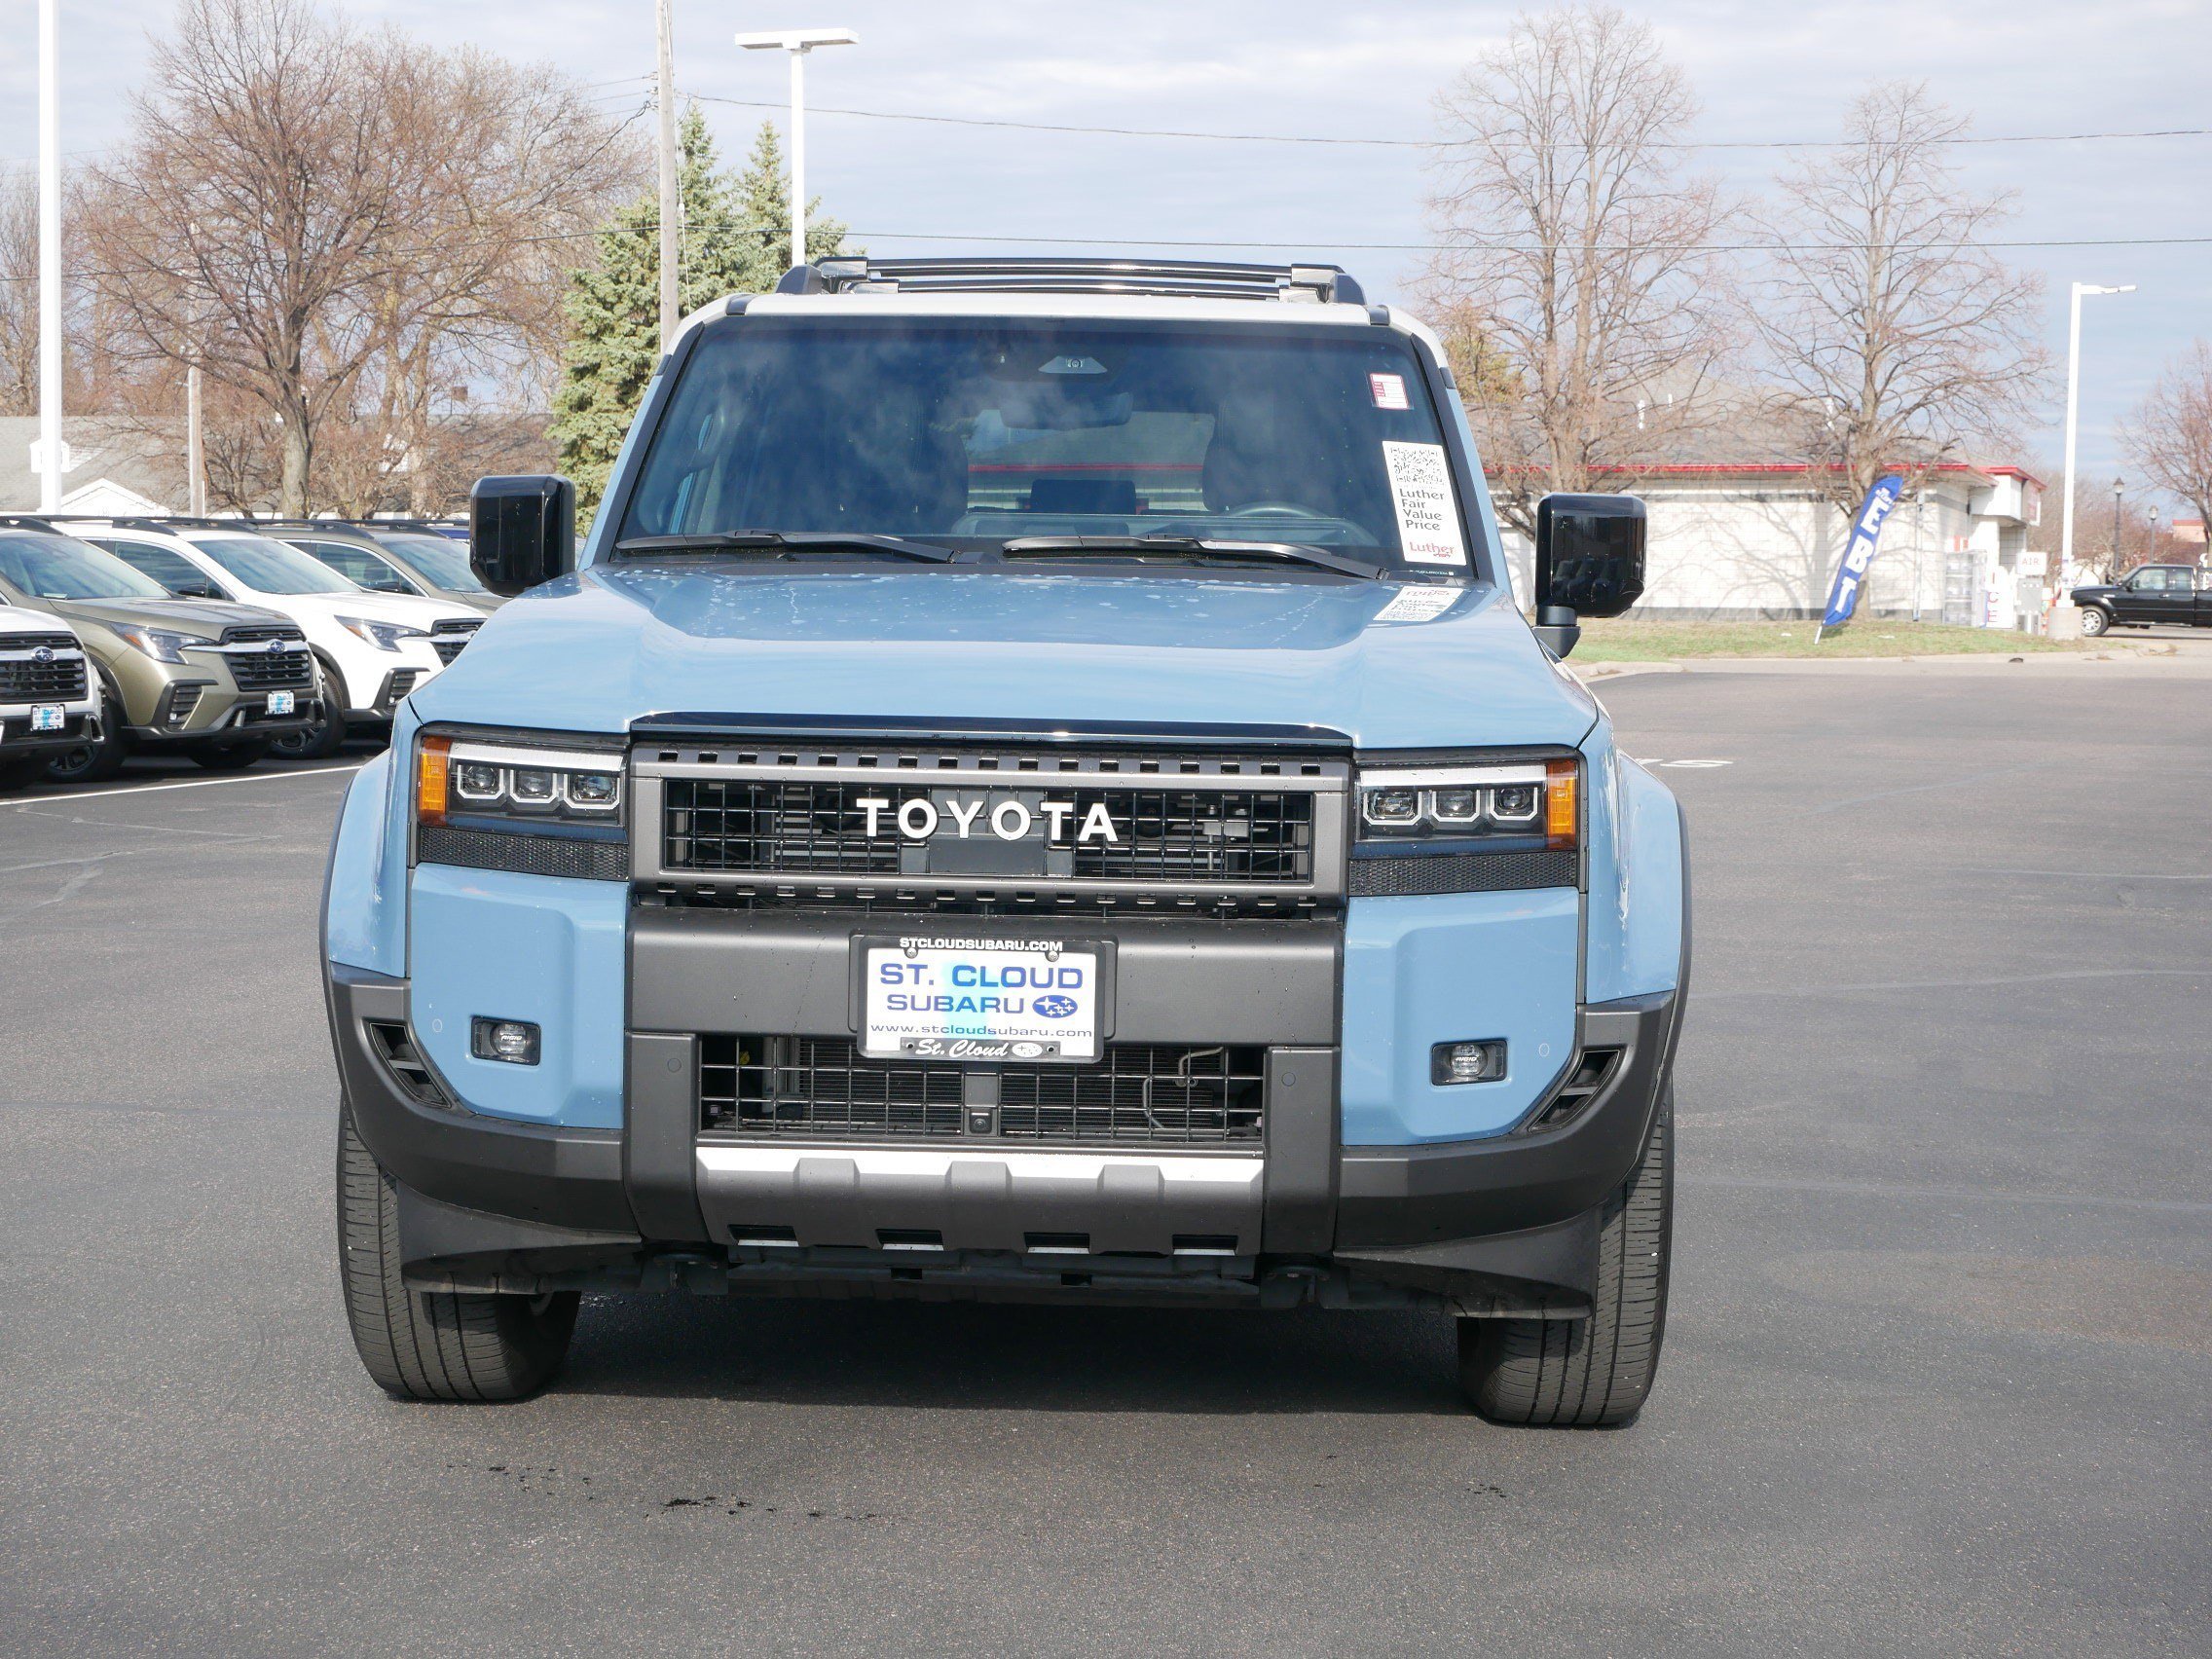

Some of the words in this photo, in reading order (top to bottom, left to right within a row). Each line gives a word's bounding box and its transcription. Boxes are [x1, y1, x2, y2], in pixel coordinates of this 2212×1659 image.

[1399, 489, 1445, 499] Luther
[1401, 498, 1426, 508] Fair
[1402, 508, 1442, 520] Value
[1405, 519, 1440, 531] Price
[1409, 541, 1455, 554] Luther
[1835, 497, 1890, 613] EBT
[2021, 557, 2040, 566] AIR
[1987, 571, 2000, 622] ICE
[856, 797, 1119, 842] TOYOTA
[900, 937, 1063, 952] STCLOUDSUBARU.COM
[880, 962, 935, 986] ST.
[951, 964, 1084, 990] CLOUD
[887, 993, 1025, 1014] SUBARU
[870, 1024, 1092, 1038] www.stcloudsubaru.com
[915, 1038, 945, 1055] St.
[948, 1039, 1010, 1058] Cloud
